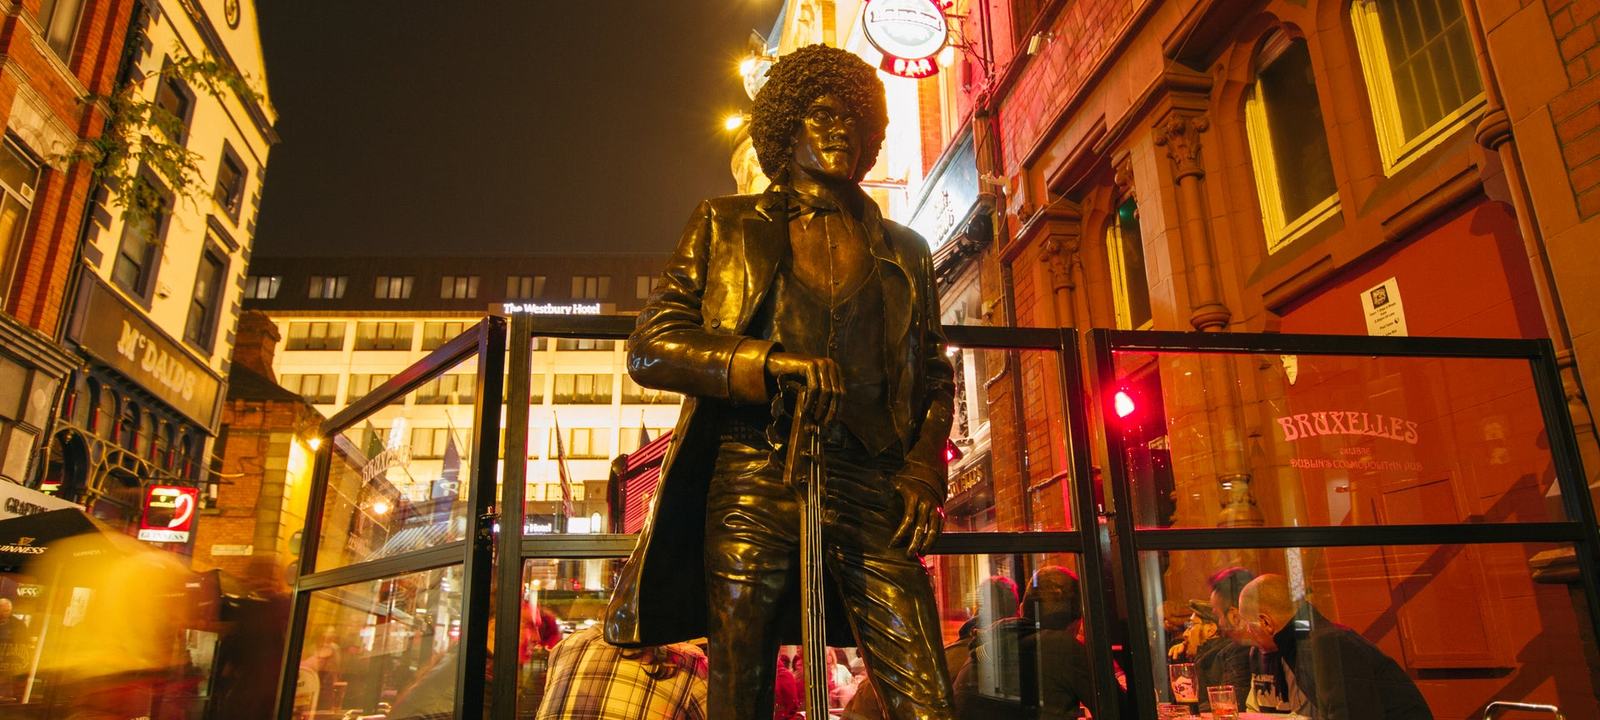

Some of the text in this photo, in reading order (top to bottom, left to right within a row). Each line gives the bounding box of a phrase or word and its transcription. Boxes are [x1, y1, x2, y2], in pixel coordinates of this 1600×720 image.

[893, 58, 932, 76] BAR
[504, 303, 600, 315] The Westbury Hotel
[1277, 411, 1418, 444] BRUXELLES
[0, 545, 48, 555] UINNESS
